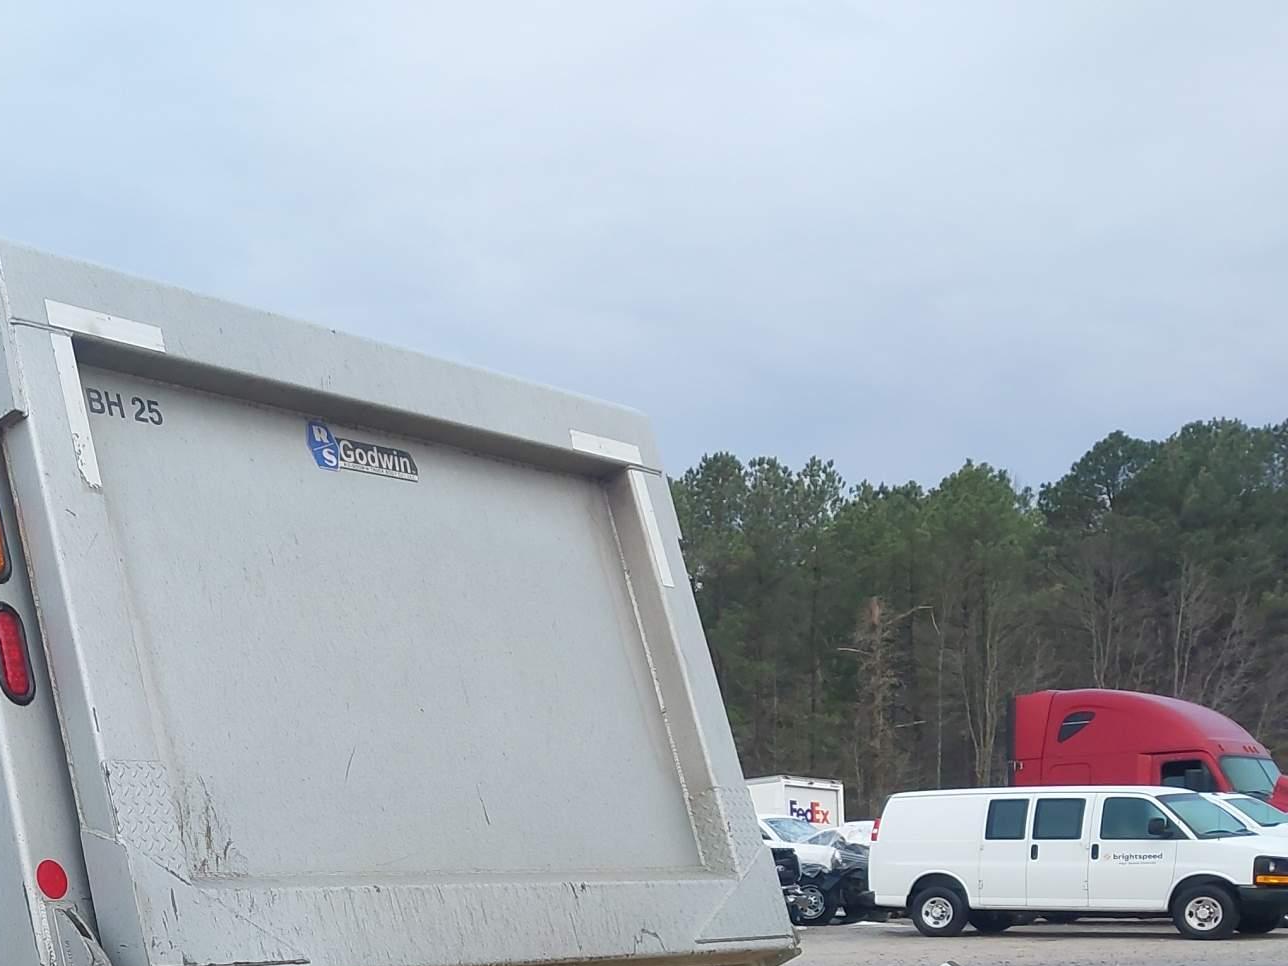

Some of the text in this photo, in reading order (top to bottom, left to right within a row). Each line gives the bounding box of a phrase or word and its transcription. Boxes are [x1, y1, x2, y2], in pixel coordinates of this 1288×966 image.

[85, 387, 163, 426] BH 25
[338, 439, 412, 474] Godwin
[789, 799, 831, 825] FedEx
[1112, 852, 1163, 862] brightspeed
